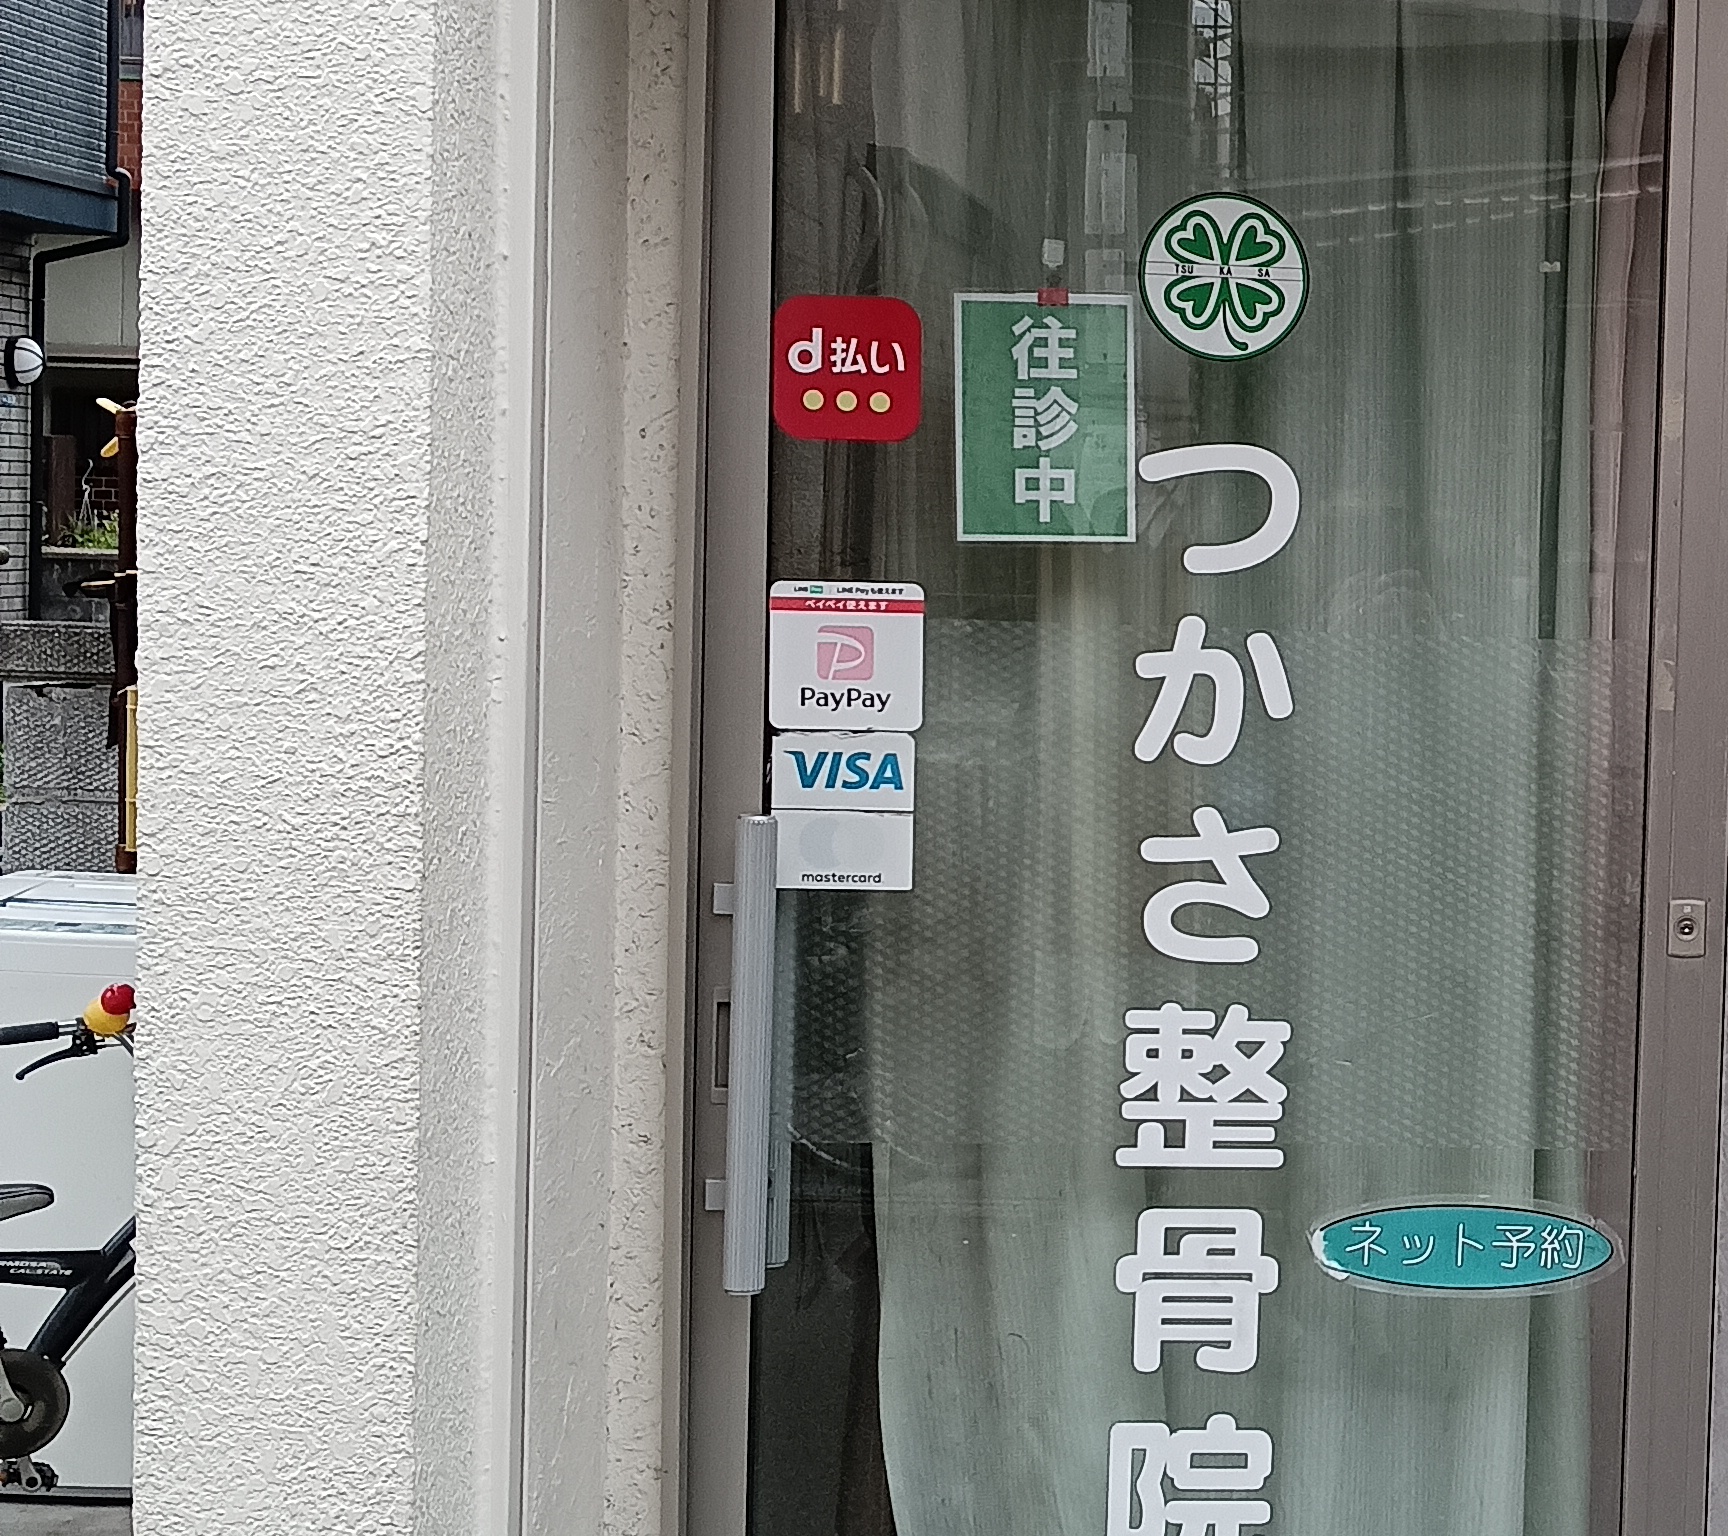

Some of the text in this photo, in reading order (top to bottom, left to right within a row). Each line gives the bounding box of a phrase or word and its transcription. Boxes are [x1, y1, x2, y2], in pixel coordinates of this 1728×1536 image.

[1174, 264, 1271, 278] TSU KA SA
[787, 327, 906, 374] d払い
[1010, 315, 1080, 524] 往診中
[800, 687, 892, 712] PayPay
[783, 750, 904, 791] VISA
[801, 871, 882, 884] mastercard
[1343, 1220, 1586, 1271] ネット予約
